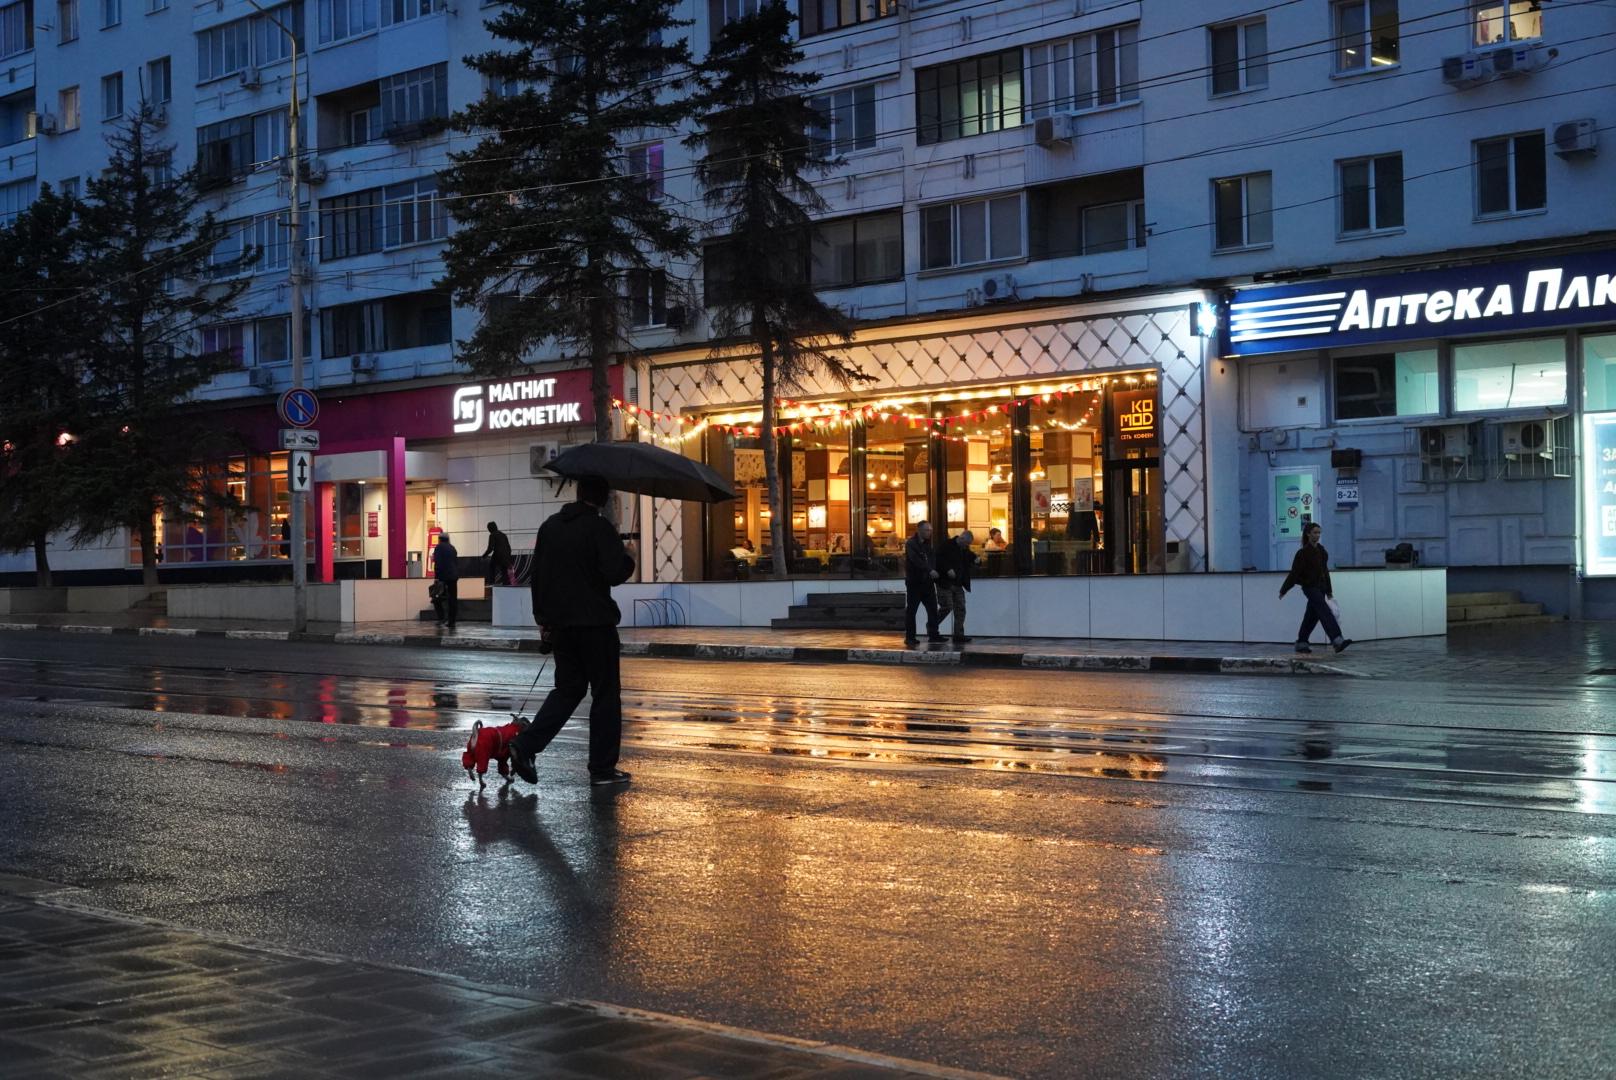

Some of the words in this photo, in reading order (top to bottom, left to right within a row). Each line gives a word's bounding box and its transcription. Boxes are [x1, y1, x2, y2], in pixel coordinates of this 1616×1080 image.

[489, 378, 557, 402] МАГНИТ
[489, 402, 581, 429] КОСМЕТИК
[1337, 490, 1357, 499] 8-22
